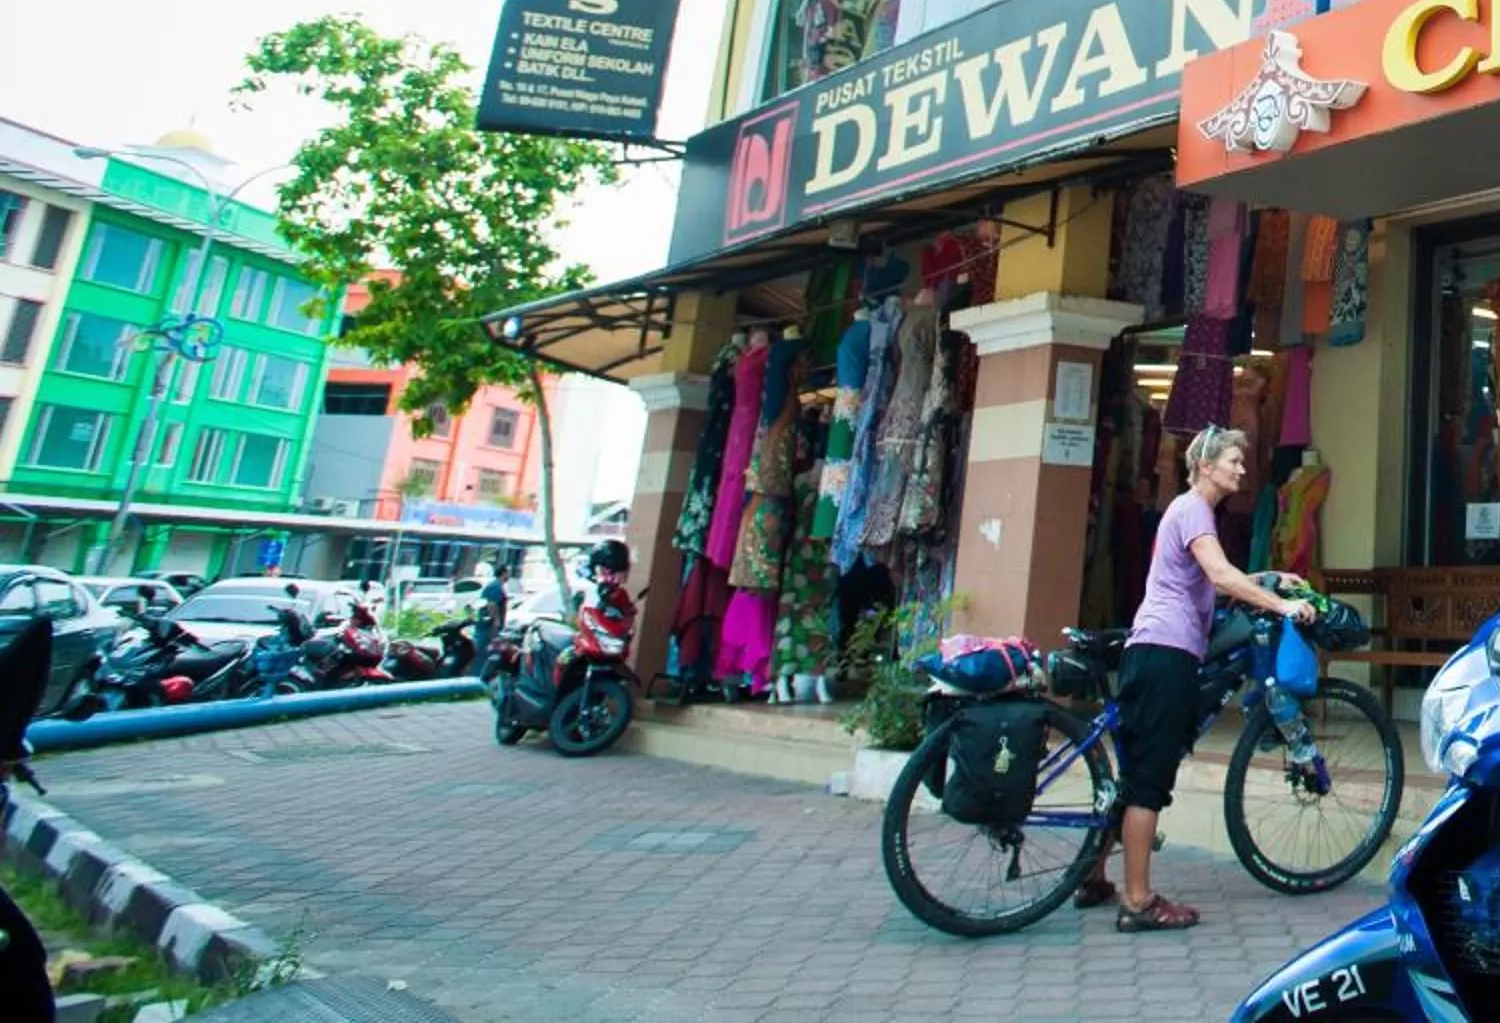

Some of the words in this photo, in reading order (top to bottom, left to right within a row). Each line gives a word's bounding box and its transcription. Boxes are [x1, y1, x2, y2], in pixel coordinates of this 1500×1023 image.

[522, 11, 588, 33] TEXTILE
[589, 21, 654, 43] CENTRE
[561, 37, 588, 53] ELA
[516, 59, 559, 78] BATIK
[815, 75, 877, 114] PUSAT
[882, 36, 965, 87] TEKSTIL
[1281, 978, 1327, 1019] VE
[1331, 963, 1367, 1003] 21
